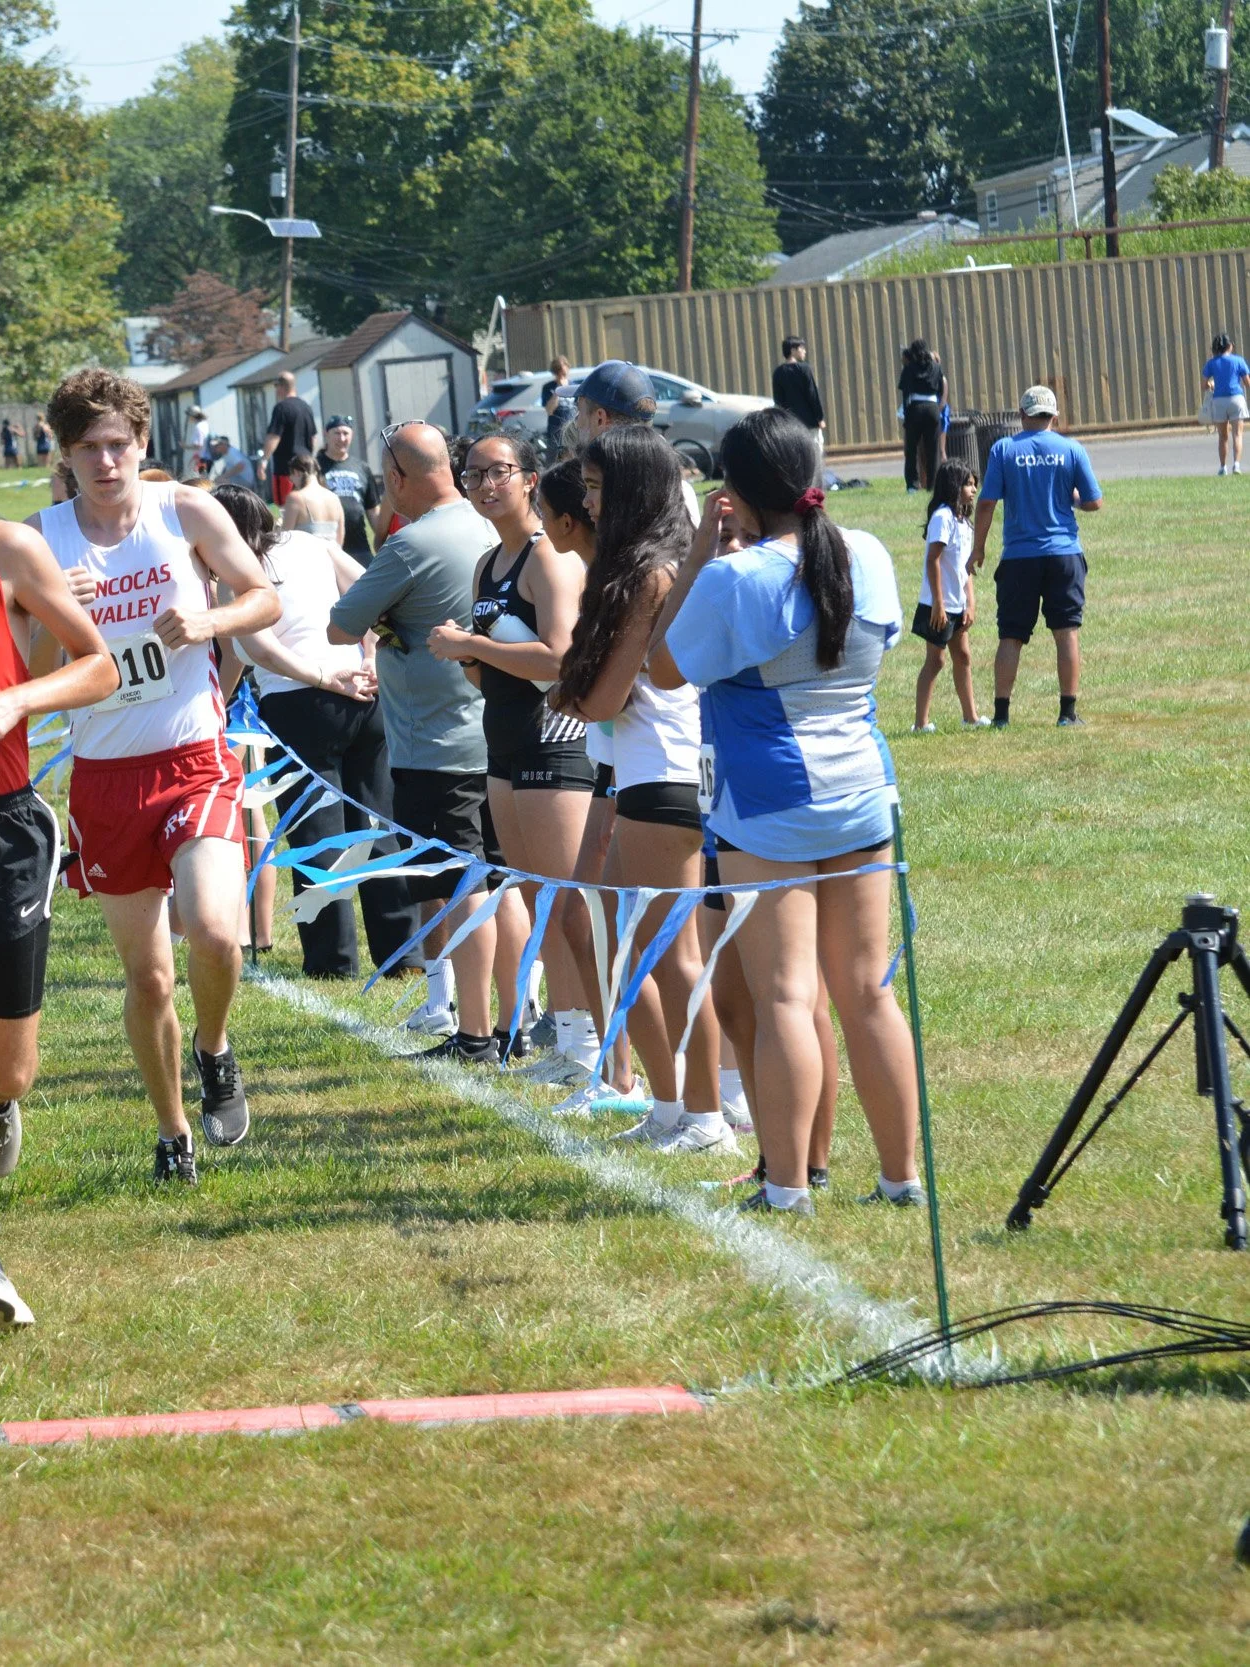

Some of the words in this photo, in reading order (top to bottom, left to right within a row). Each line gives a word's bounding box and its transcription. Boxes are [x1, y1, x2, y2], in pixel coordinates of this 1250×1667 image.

[1015, 453, 1065, 467] COACH
[95, 563, 172, 599] NCOCAS
[91, 594, 161, 626] VALLEY
[521, 770, 553, 781] NIKE
[164, 803, 196, 841] RV
